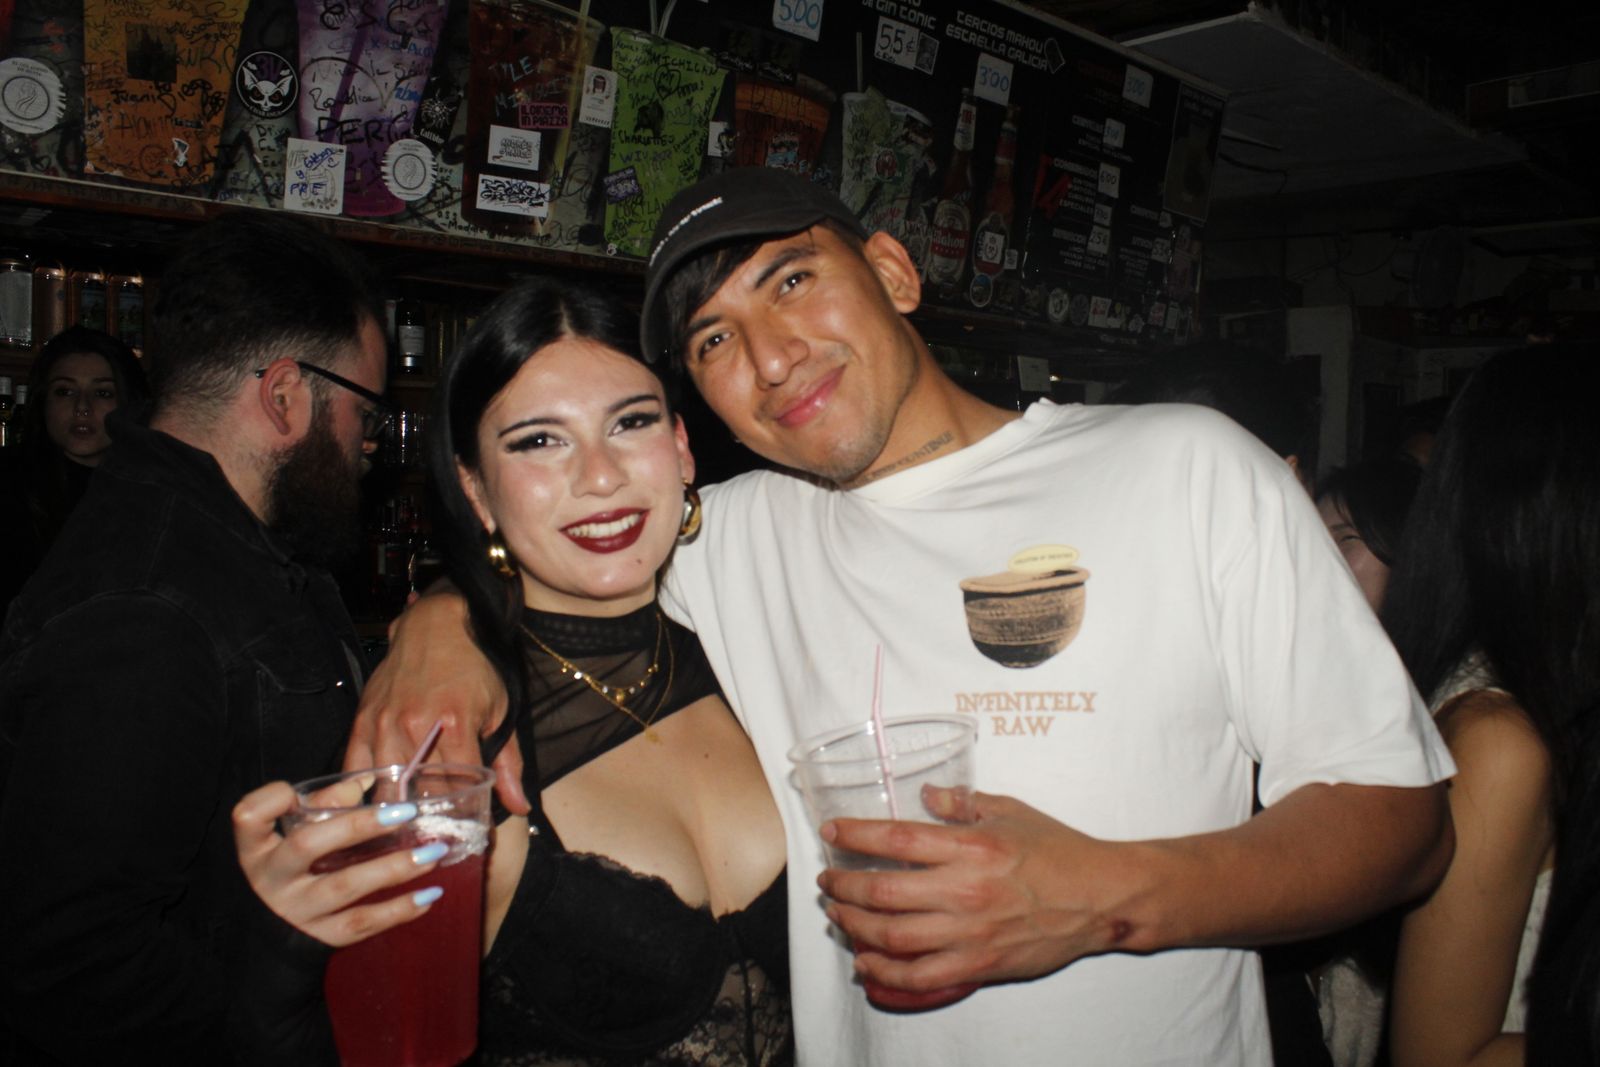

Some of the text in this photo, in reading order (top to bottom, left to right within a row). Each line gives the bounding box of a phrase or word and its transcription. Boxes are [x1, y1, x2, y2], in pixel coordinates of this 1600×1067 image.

[898, 4, 937, 30] TONIC
[956, 9, 1044, 54] TERCIOS MAHOU
[945, 23, 1007, 56] ESTRELLA
[1007, 45, 1049, 72] GALICIA
[533, 116, 568, 126] PIAZZA
[955, 691, 1098, 713] INFINITELY
[991, 715, 1056, 737] RAW
